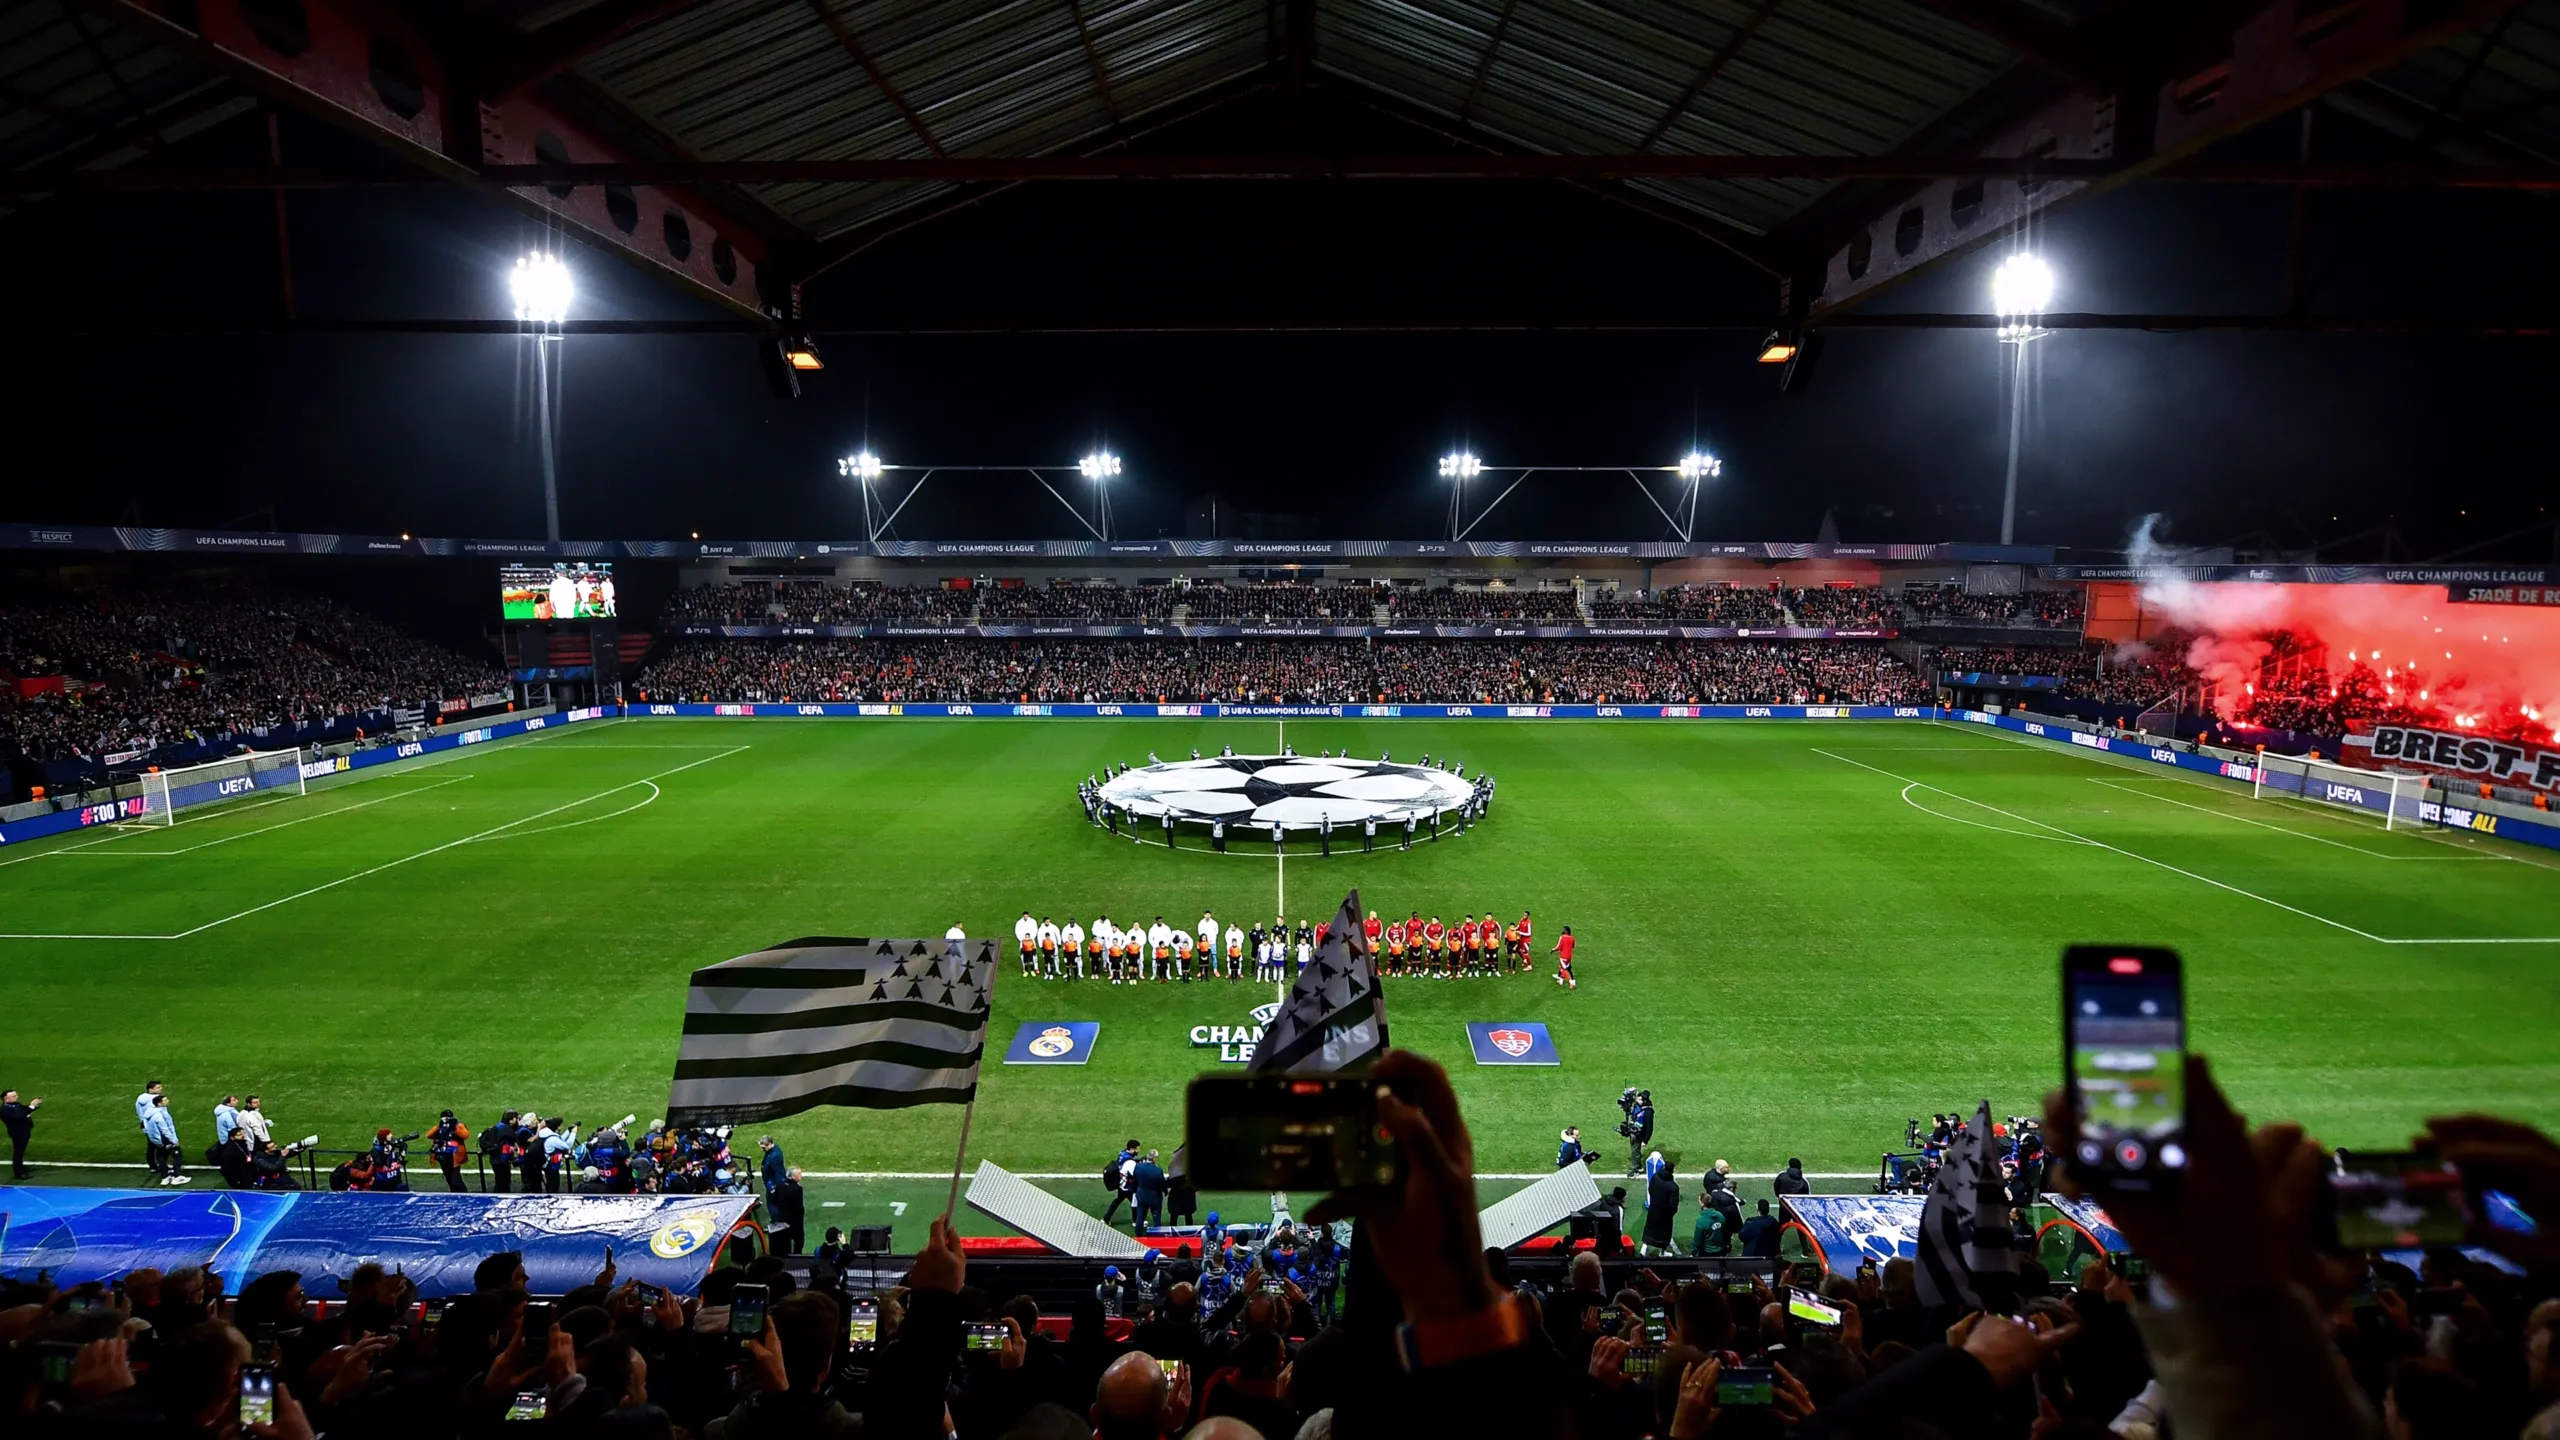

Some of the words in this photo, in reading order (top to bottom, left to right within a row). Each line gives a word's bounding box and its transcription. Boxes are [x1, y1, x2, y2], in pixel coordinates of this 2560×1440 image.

[196, 537, 216, 545] UEFA
[217, 538, 259, 546] CHAMPIONS
[260, 539, 286, 547] LEAGUE
[2386, 571, 2414, 580] UEFA
[2417, 571, 2490, 581] CHAMPIONS
[2493, 571, 2545, 582] LEAGUE
[2468, 588, 2513, 602] STADE
[2519, 590, 2538, 603] DE
[651, 705, 676, 714] UEFA
[798, 705, 824, 715] UEFA
[948, 706, 973, 715] UEFA
[1097, 706, 1122, 715] UEFA
[1253, 707, 1299, 715] CHAMPIONS
[1447, 707, 1472, 716] UEFA
[1597, 707, 1622, 716] UEFA
[1746, 708, 1771, 717] UEFA
[1894, 708, 1919, 717] UEFA
[526, 718, 545, 730] UEFA
[2025, 722, 2044, 736] UEFA
[398, 742, 423, 757] UEFA
[2371, 726, 2524, 779] BREST
[2151, 748, 2176, 764] UEFA
[219, 777, 255, 795] UEFA
[2327, 784, 2363, 804] UEFA
